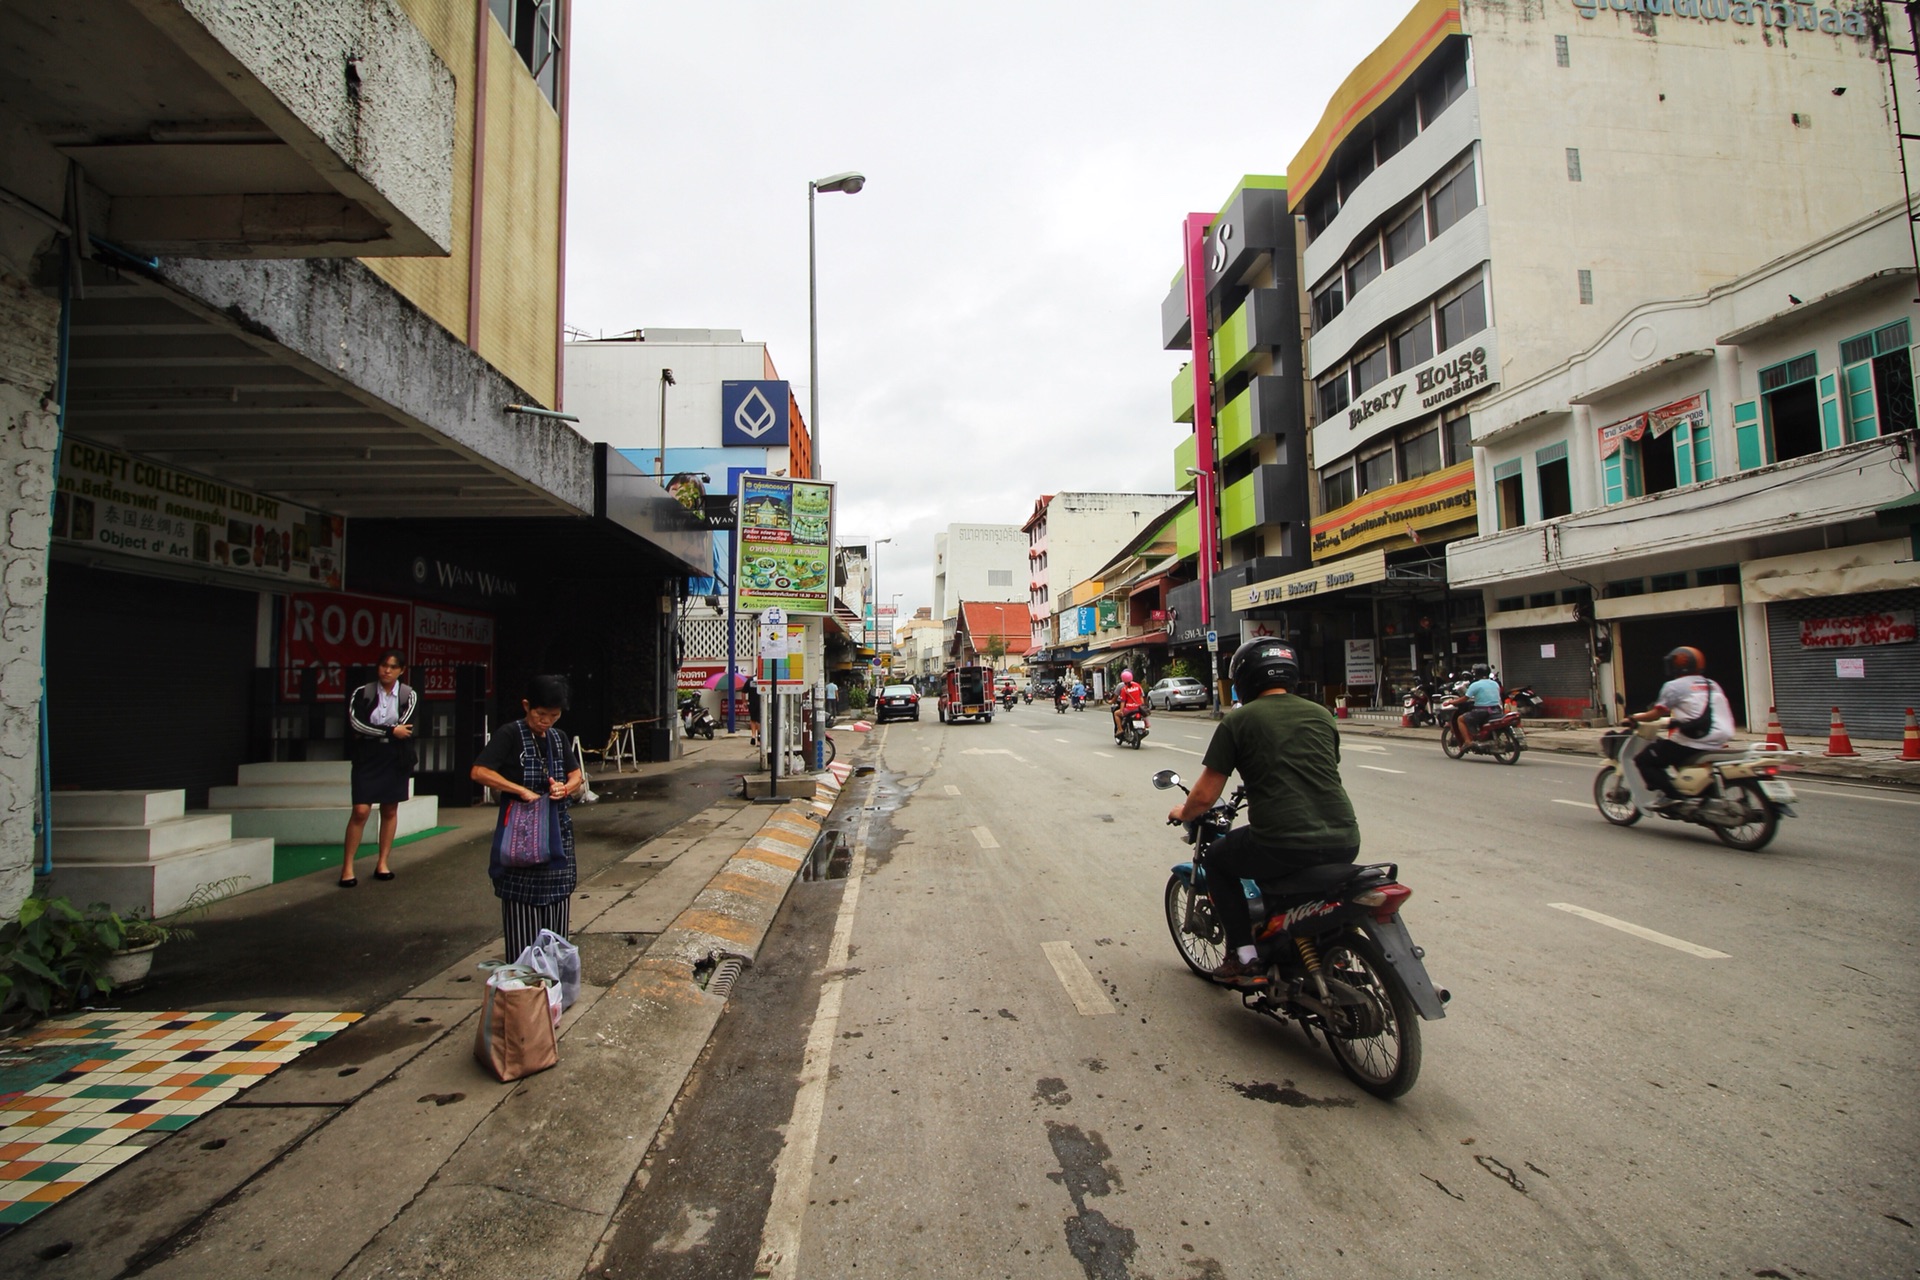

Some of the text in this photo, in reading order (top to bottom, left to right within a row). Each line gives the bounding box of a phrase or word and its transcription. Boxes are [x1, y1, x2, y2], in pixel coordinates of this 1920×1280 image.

[1348, 346, 1486, 431] Bakery House
[70, 443, 130, 482] CRAFT
[132, 462, 226, 508] COLLECTION
[104, 505, 186, 539] 泰国丝绸店
[99, 528, 147, 551] Object
[169, 543, 190, 558] Art
[1264, 572, 1355, 601] UFM Bakery House
[293, 599, 404, 649] ROOM
[418, 642, 446, 651] CONTACT
[1282, 900, 1326, 930] Nice
